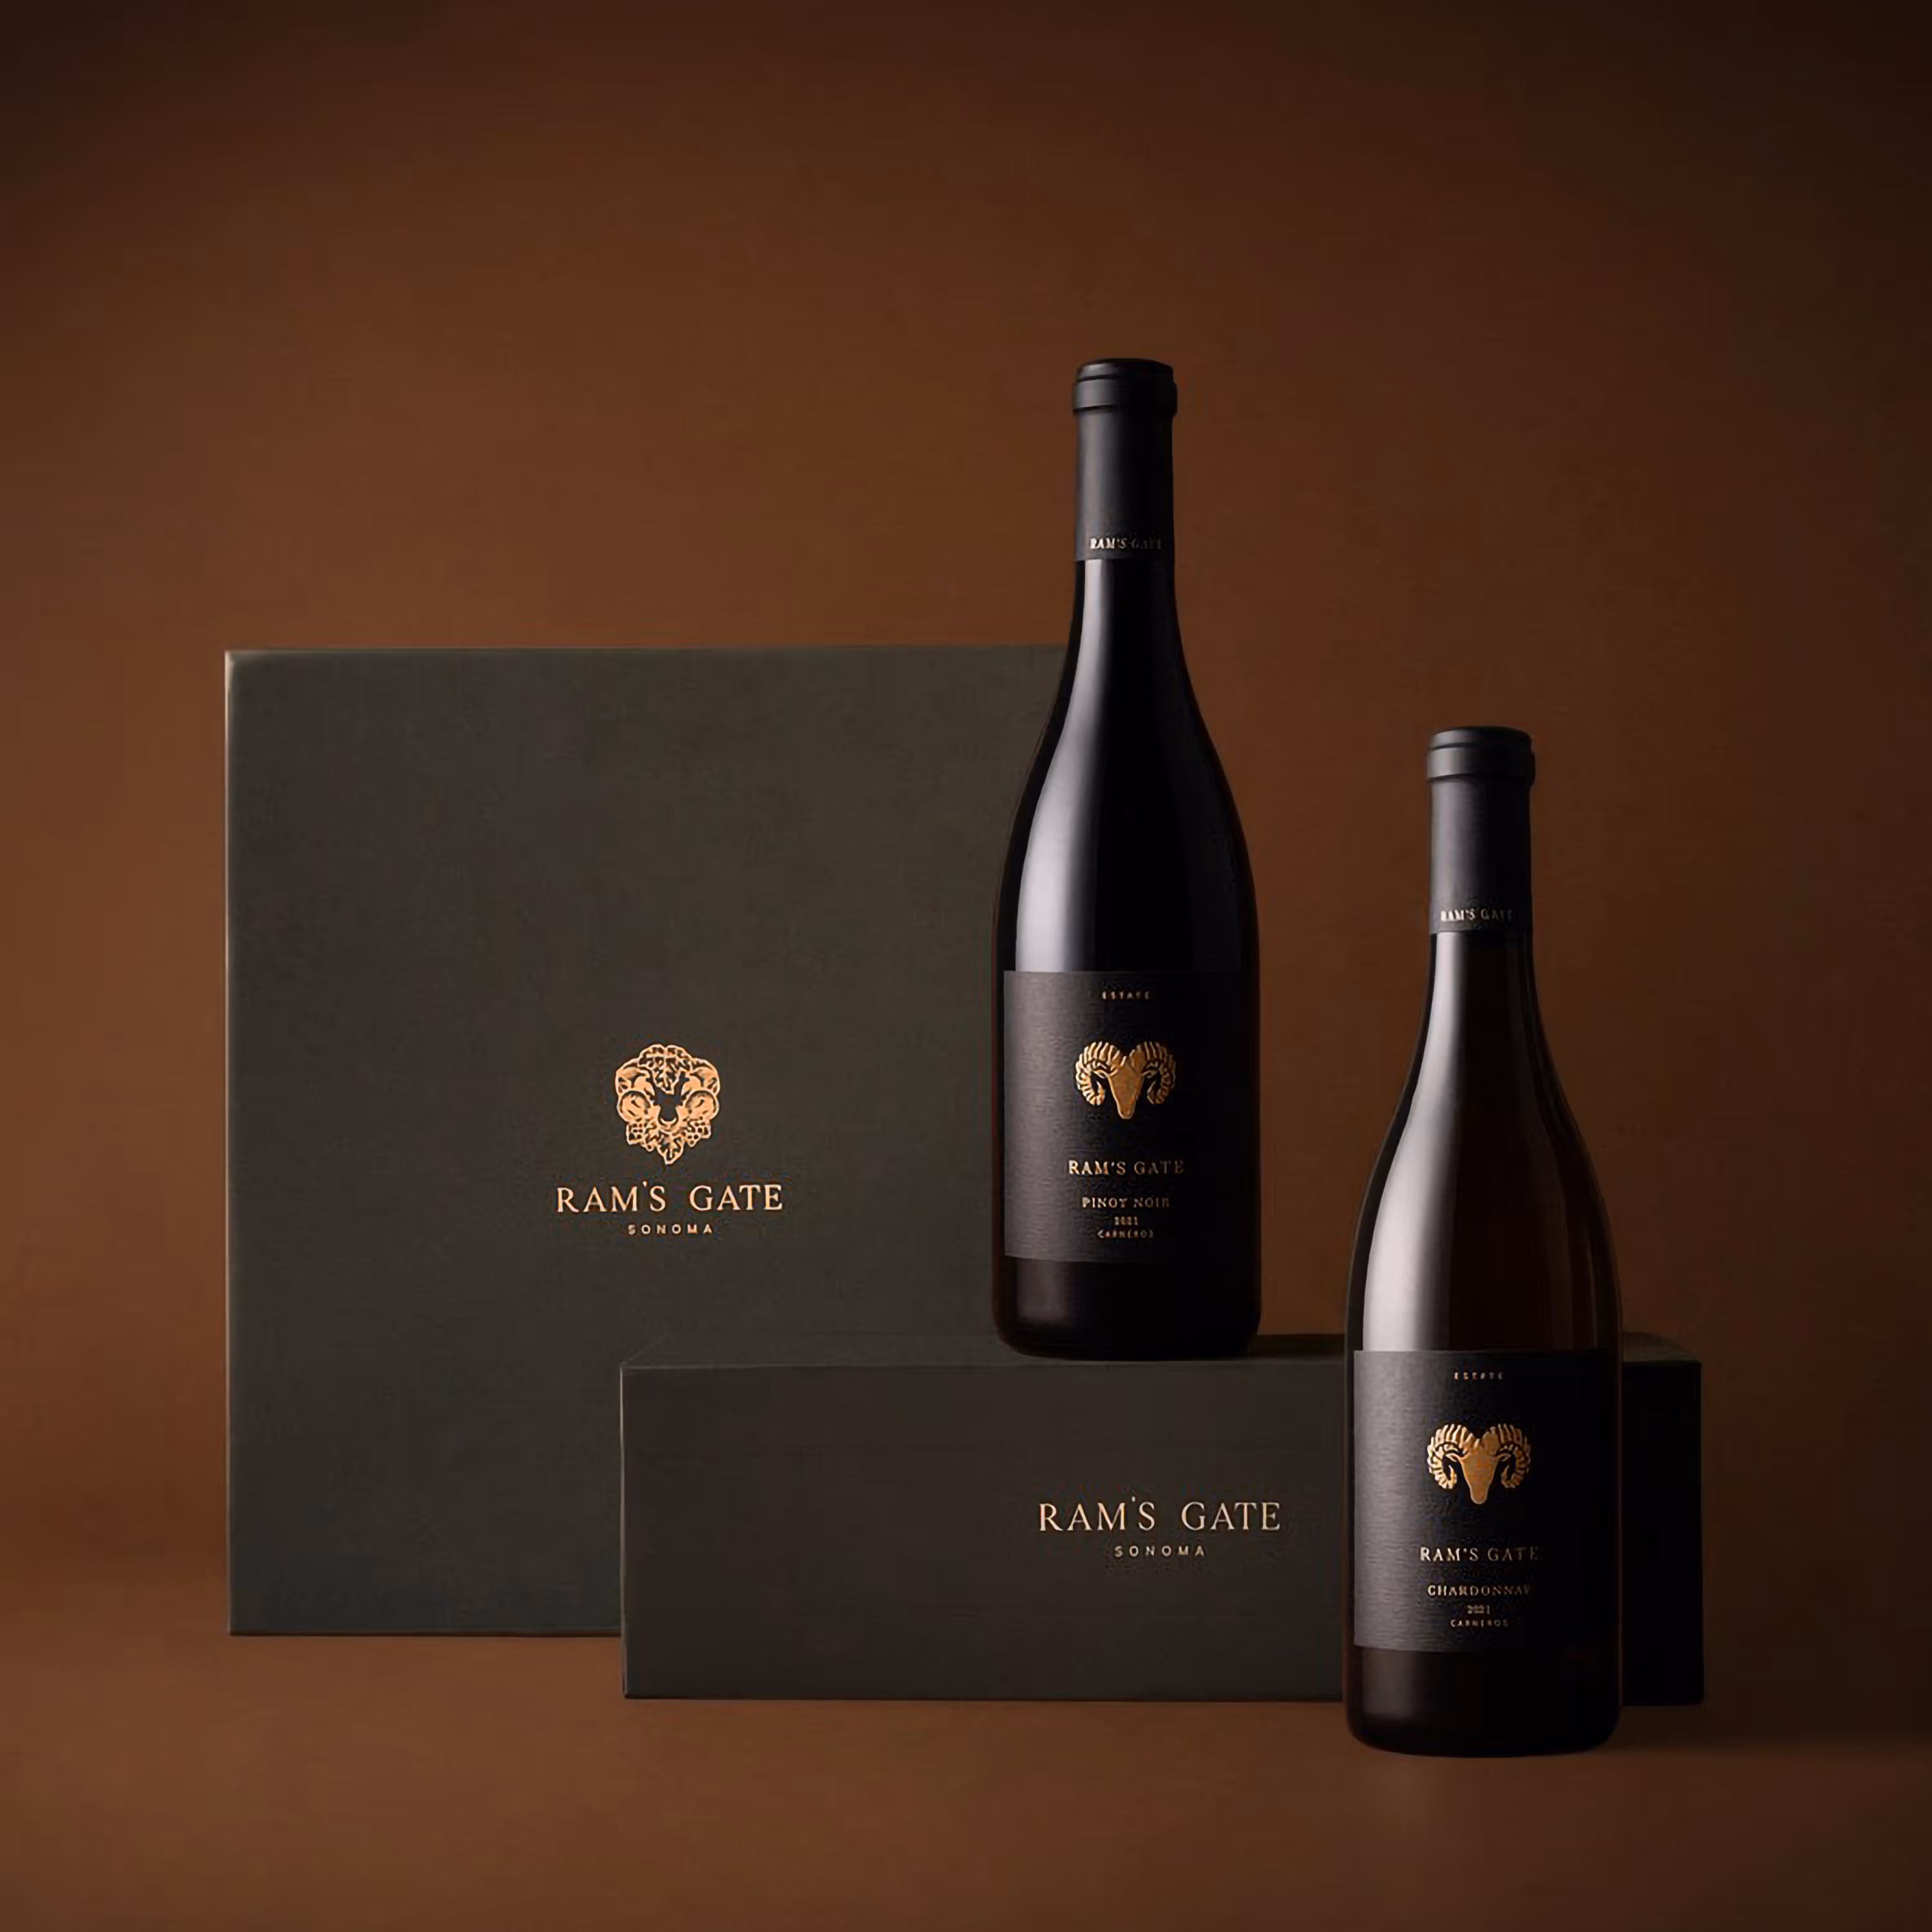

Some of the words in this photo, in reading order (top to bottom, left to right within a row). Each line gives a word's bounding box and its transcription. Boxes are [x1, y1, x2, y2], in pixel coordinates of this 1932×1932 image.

[1068, 1159, 1126, 1175] RAM'S
[1133, 1159, 1186, 1175] GATE
[556, 1181, 666, 1213] RAM'S
[689, 1184, 783, 1211] GATE
[1082, 1196, 1128, 1208] PINOT
[1133, 1196, 1170, 1208] NOIR
[627, 1224, 713, 1235] SONOMA
[1039, 1497, 1155, 1531] RAM'S
[1182, 1501, 1281, 1531] GATE
[1114, 1545, 1205, 1557] SONOMA
[1420, 1546, 1479, 1562] RAM'S
[1487, 1546, 1541, 1562] GATE
